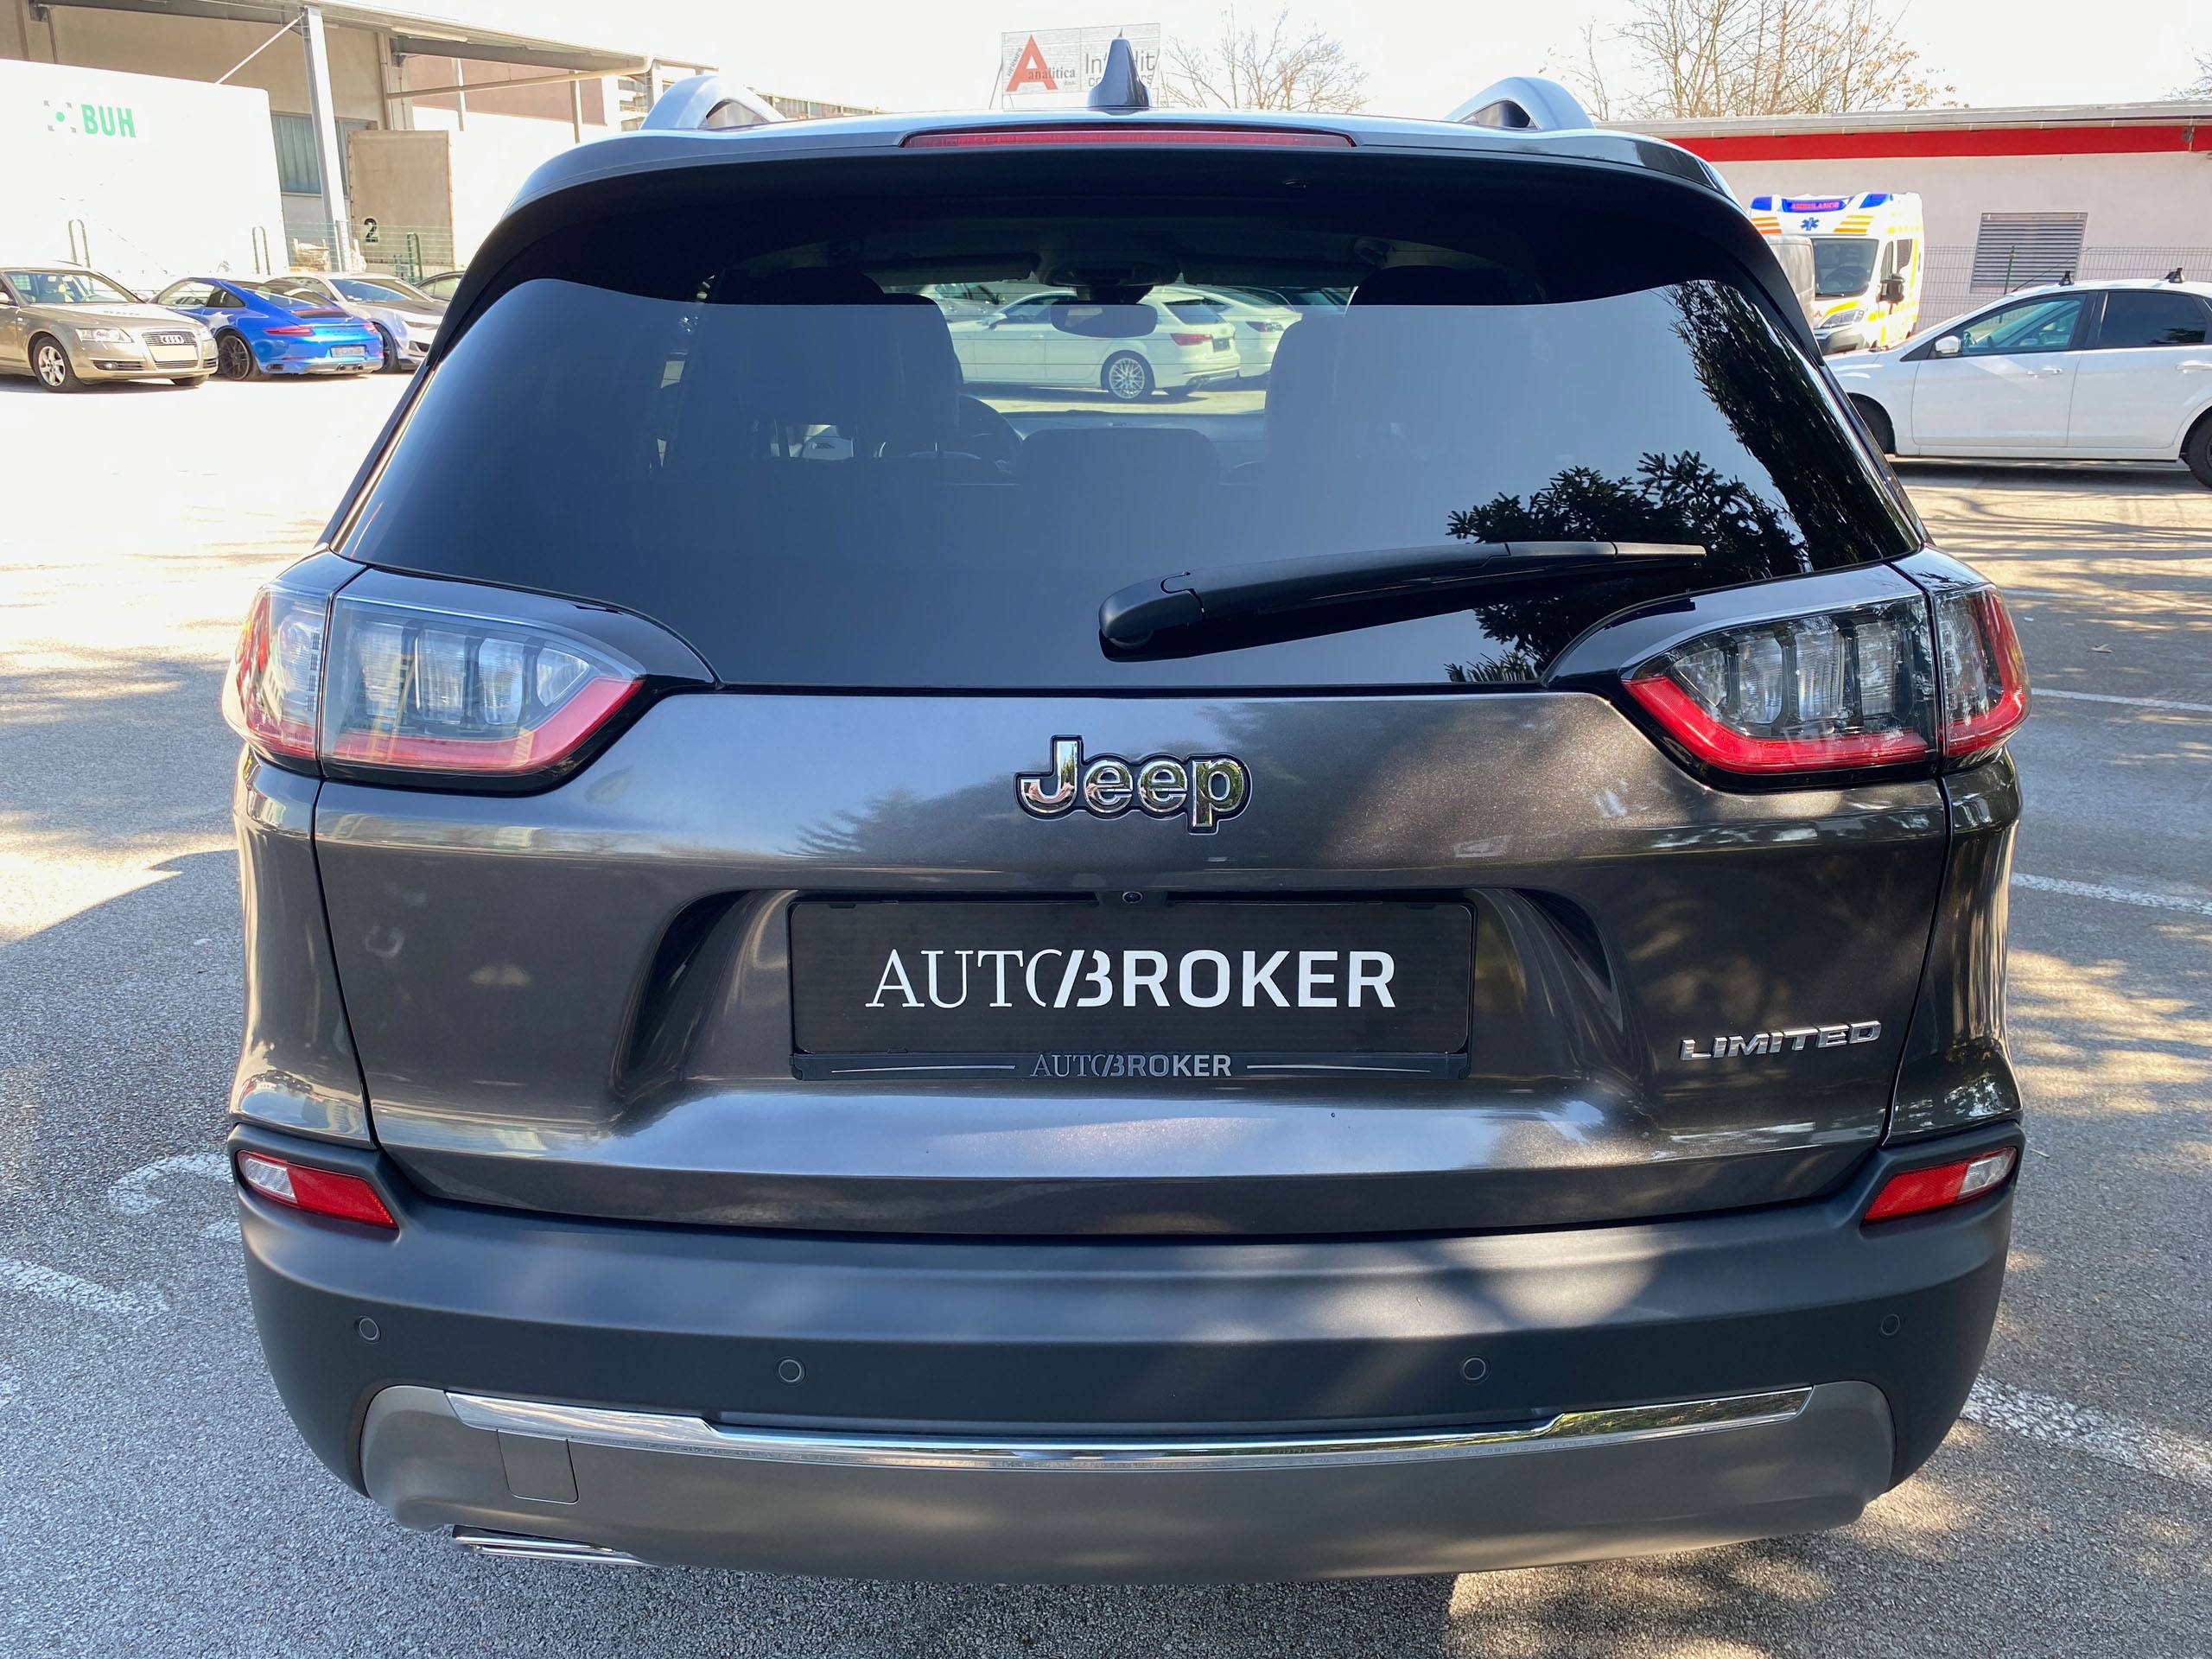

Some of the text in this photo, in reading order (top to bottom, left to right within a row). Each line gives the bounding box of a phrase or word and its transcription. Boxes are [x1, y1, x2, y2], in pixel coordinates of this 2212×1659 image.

[81, 104, 136, 138] BUH
[364, 218, 378, 242] 2
[1017, 738, 1248, 830] Jeep
[1681, 1020, 1882, 1060] LIMITED
